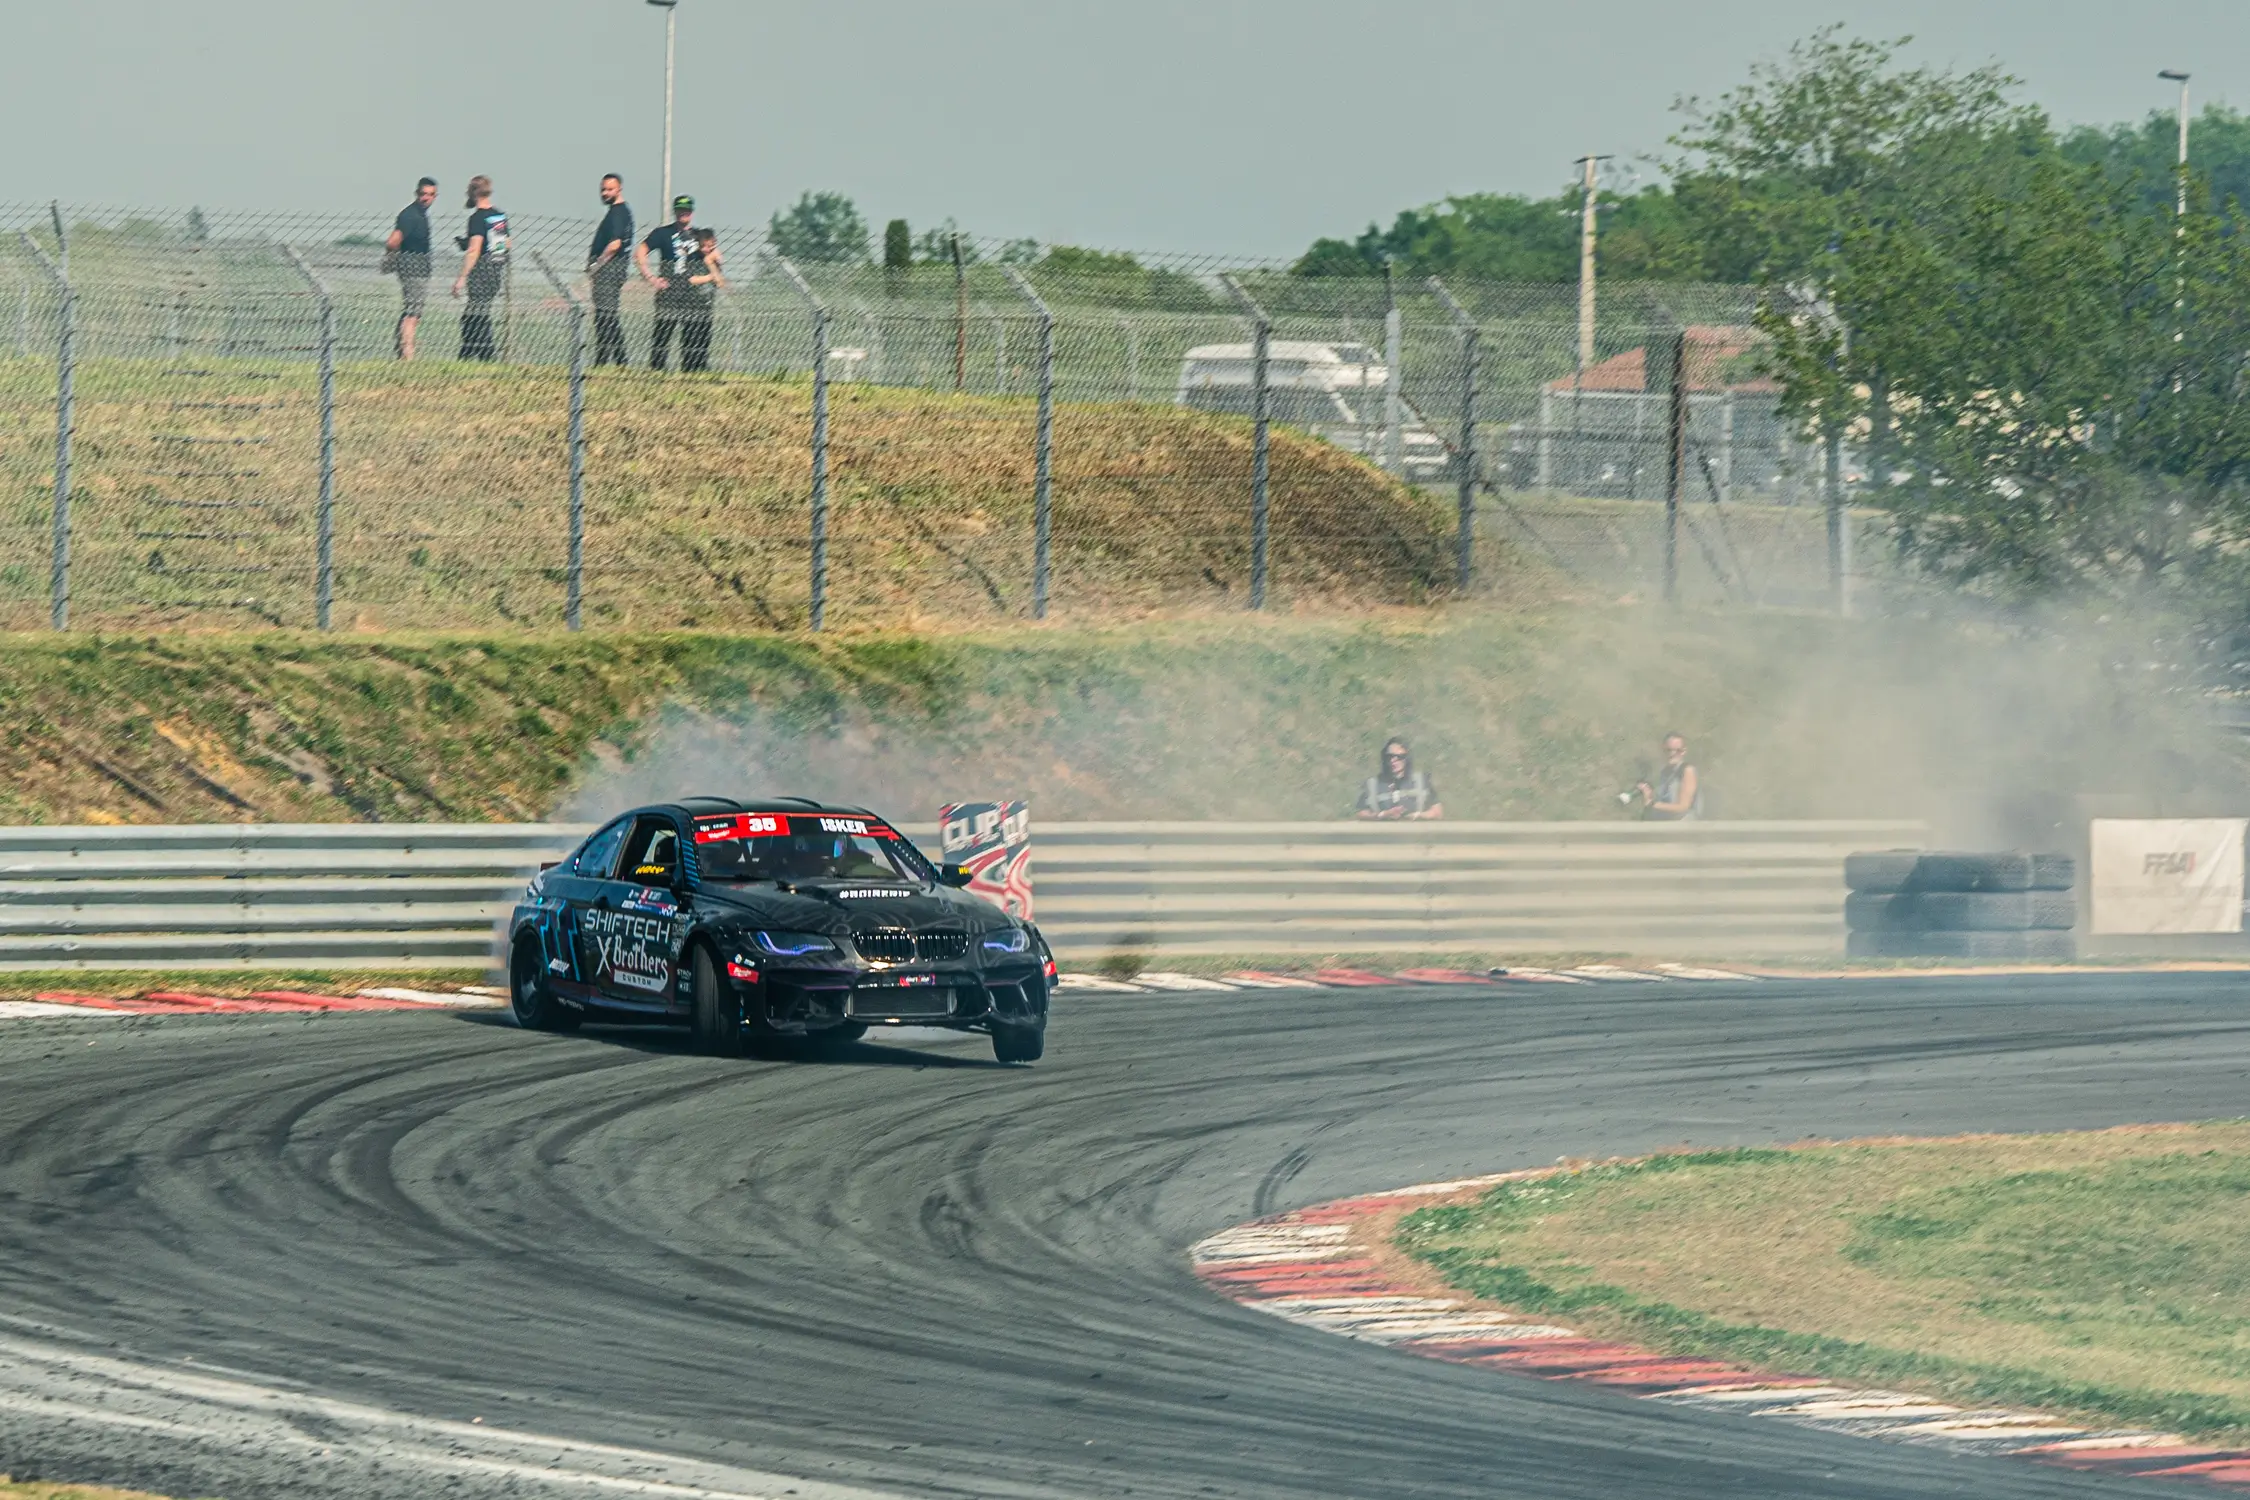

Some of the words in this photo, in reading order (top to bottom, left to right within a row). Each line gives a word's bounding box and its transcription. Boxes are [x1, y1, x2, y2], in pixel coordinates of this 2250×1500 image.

[820, 818, 868, 834] ISKER
[585, 908, 671, 943] SHIFTECH
[613, 934, 668, 981] Brothers
